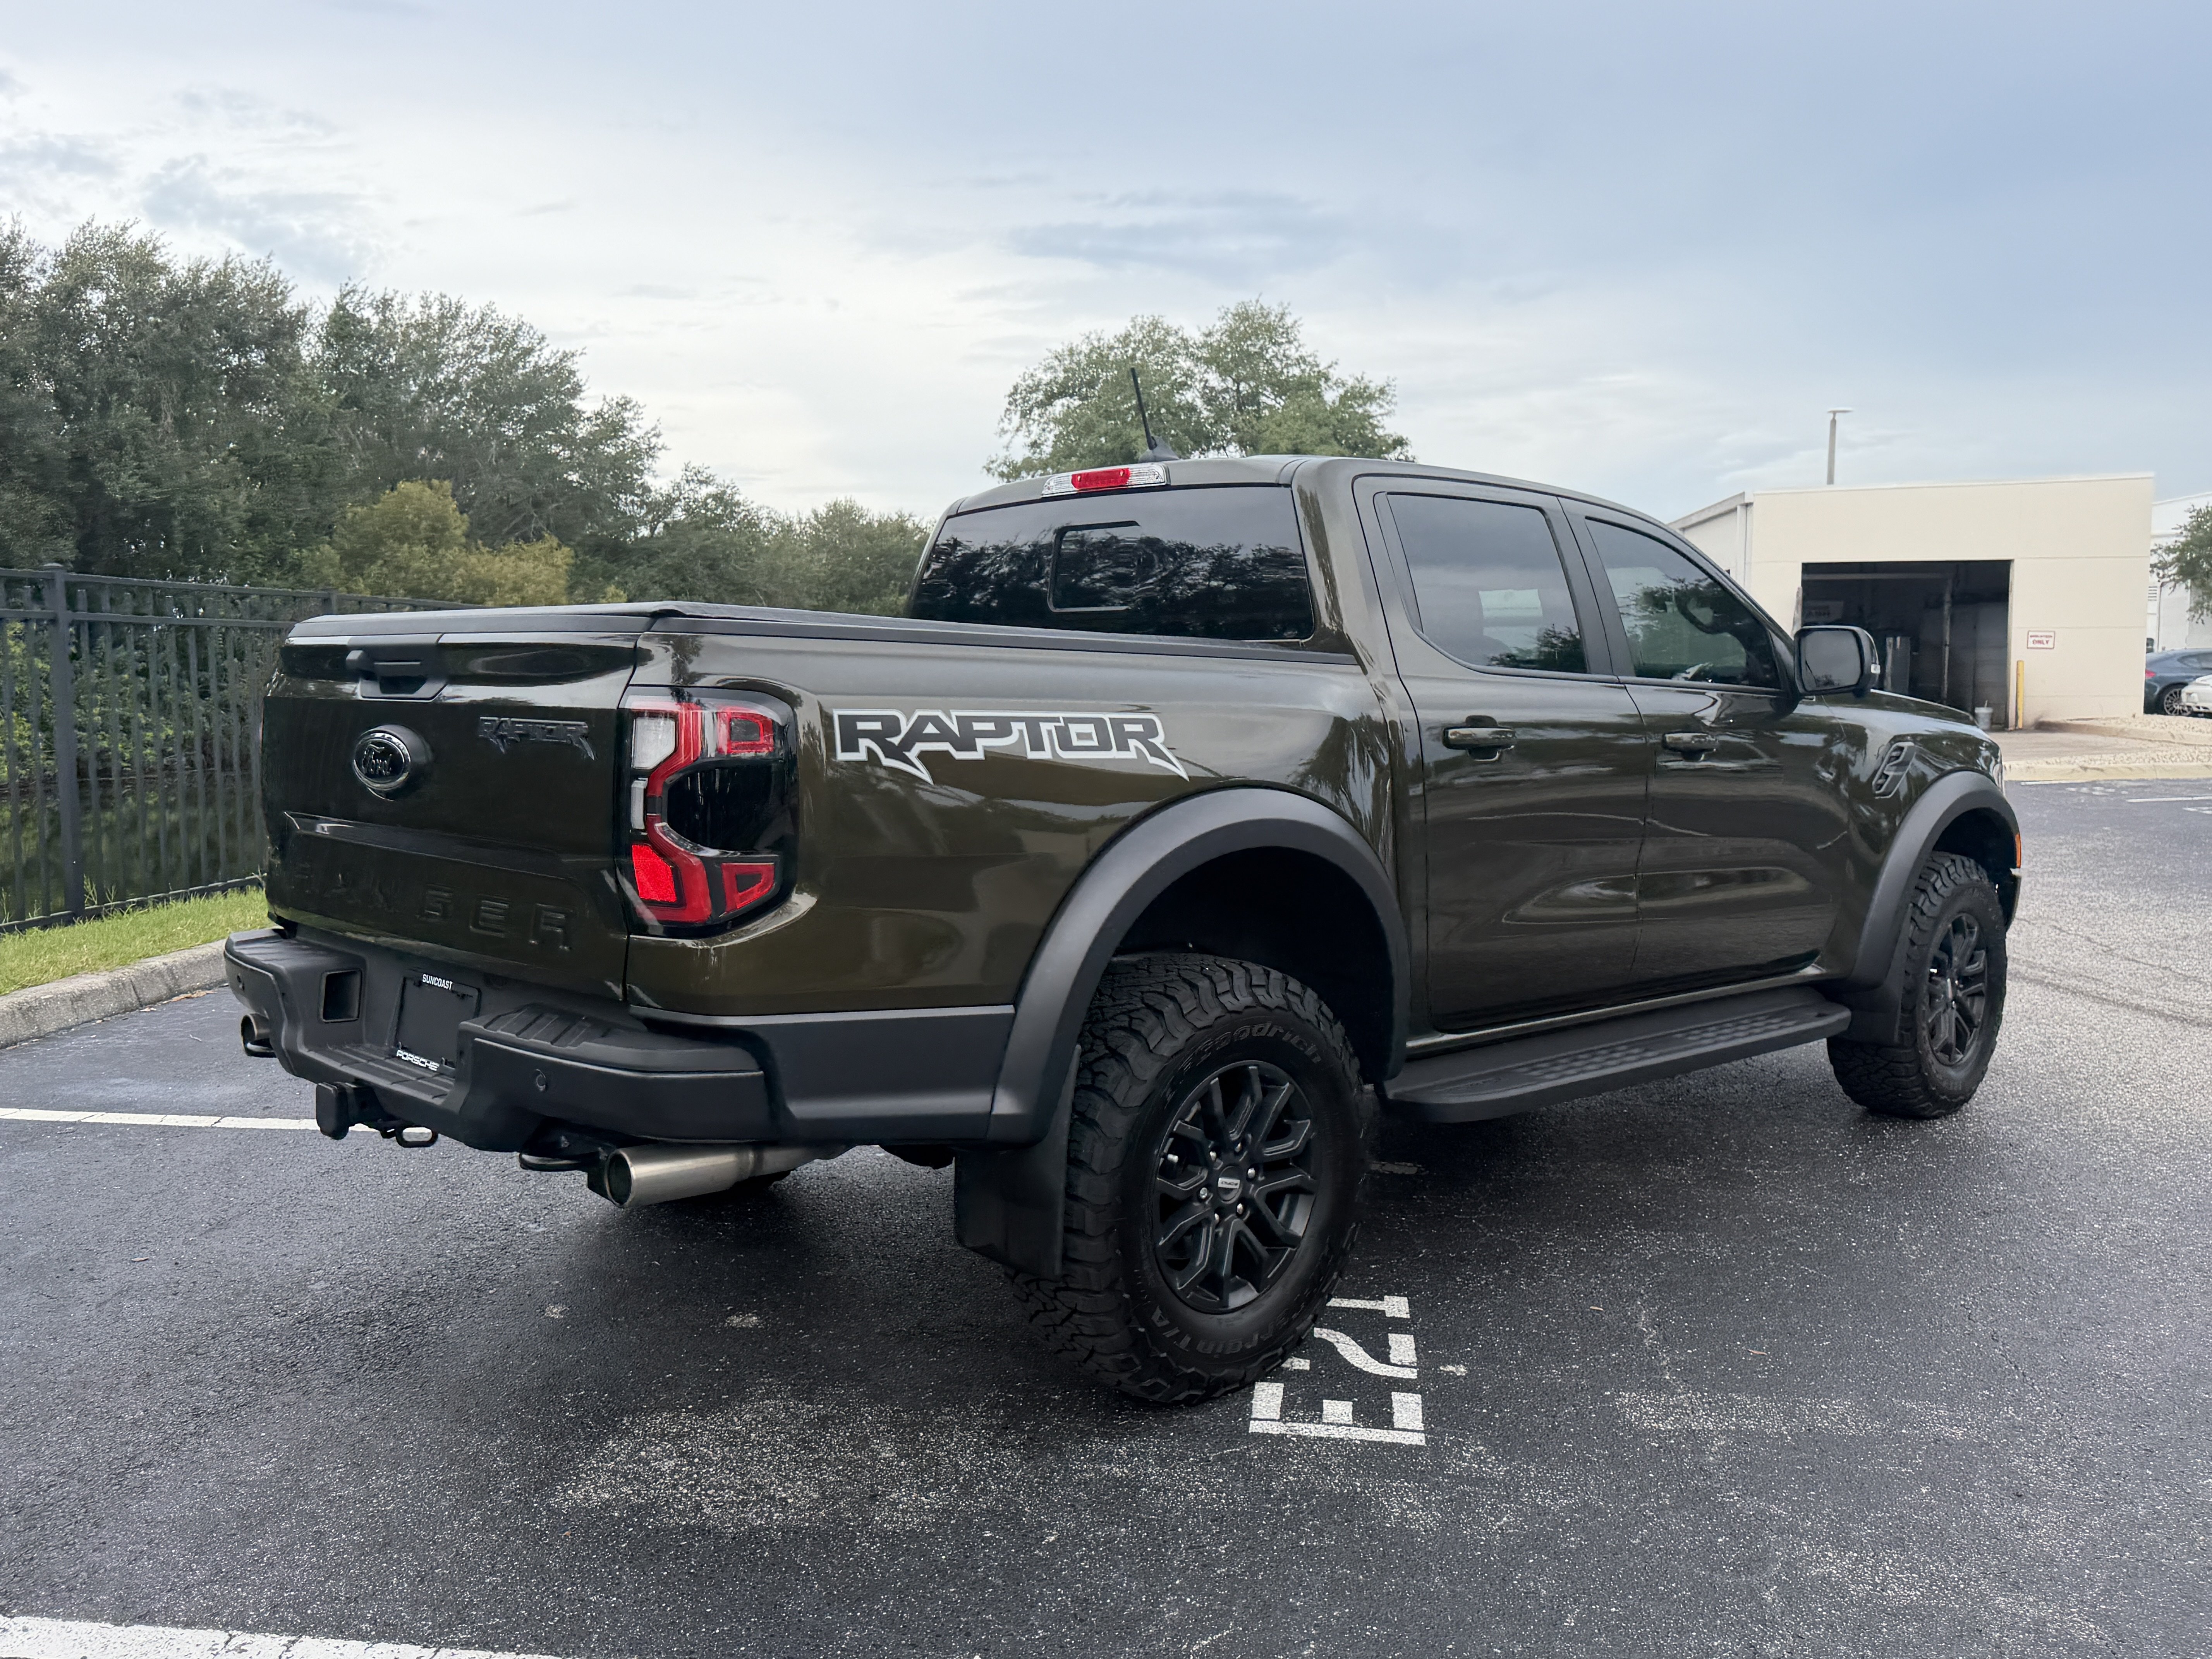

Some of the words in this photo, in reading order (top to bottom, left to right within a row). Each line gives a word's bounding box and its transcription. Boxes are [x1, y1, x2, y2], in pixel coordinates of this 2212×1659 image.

[478, 716, 596, 761] RAPTOR
[833, 709, 1190, 785] RAPTOR
[422, 974, 453, 991] SUNCOAST
[396, 1049, 440, 1071] PORSCHE
